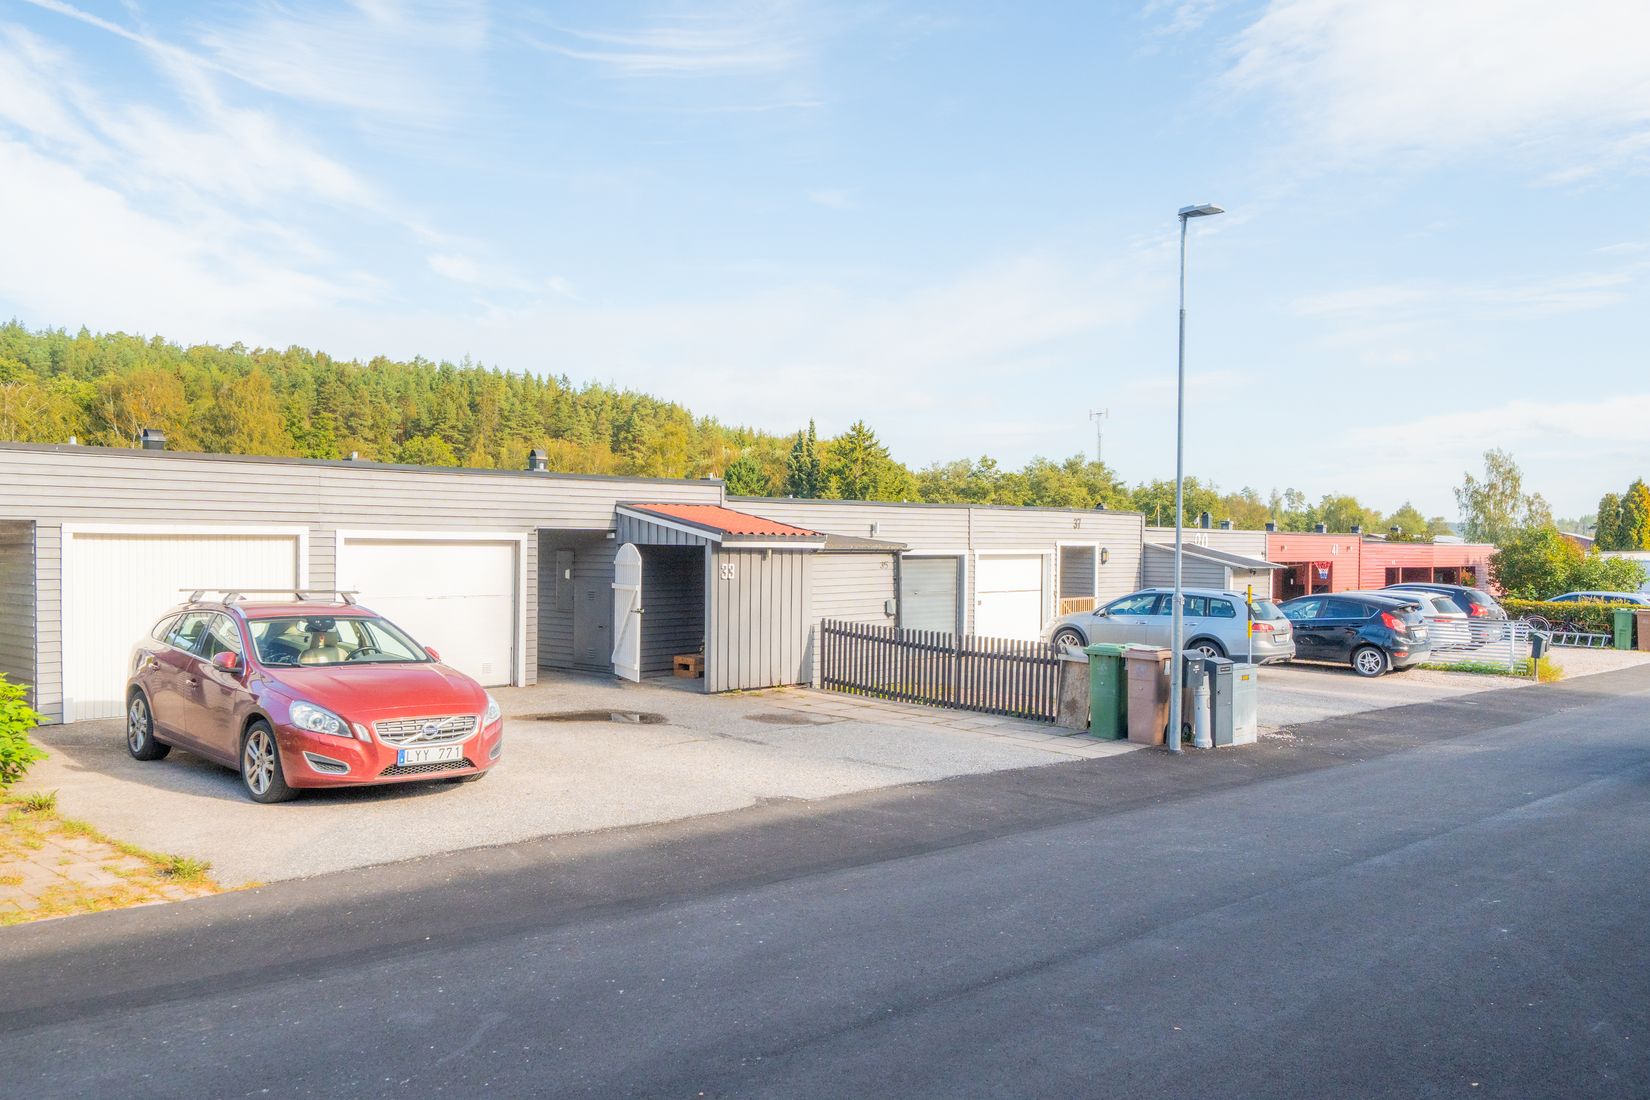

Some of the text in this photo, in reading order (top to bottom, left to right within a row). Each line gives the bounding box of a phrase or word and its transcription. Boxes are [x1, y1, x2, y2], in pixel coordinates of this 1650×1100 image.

[720, 563, 735, 580] 33
[406, 746, 460, 763] LYY 771
